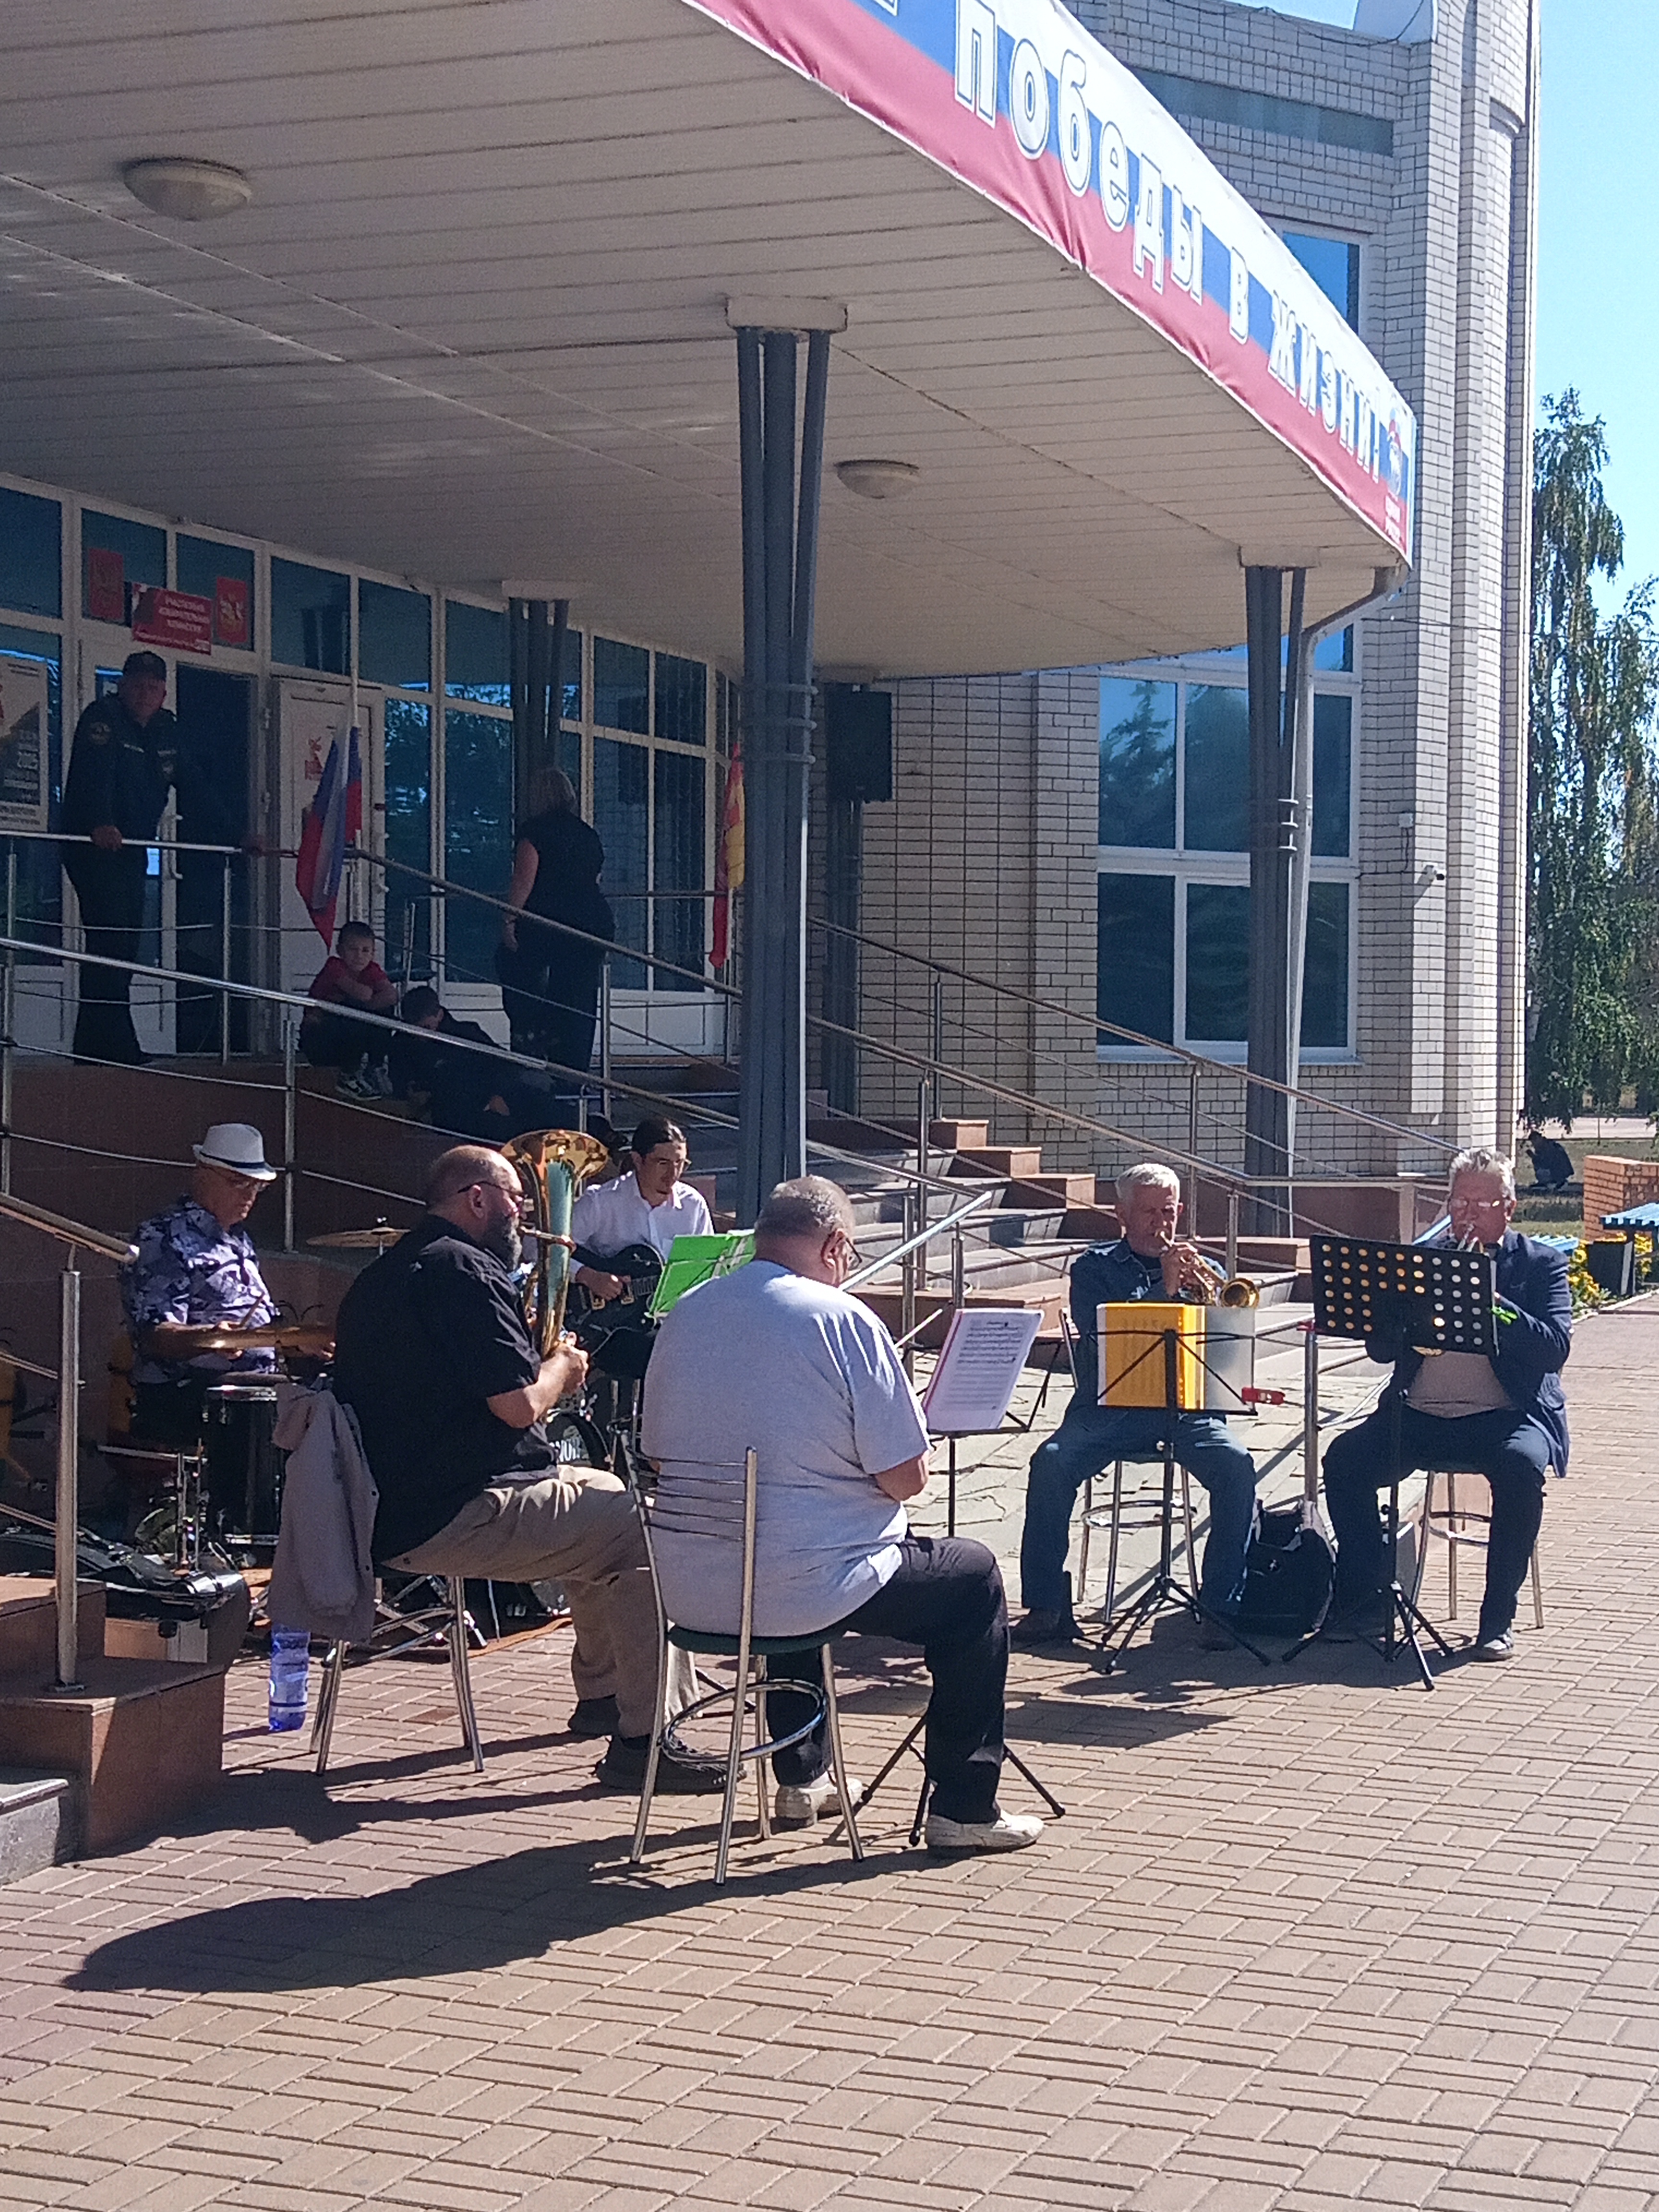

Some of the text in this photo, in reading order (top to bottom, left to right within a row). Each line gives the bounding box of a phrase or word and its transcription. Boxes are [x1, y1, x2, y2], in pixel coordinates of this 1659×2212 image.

[955, 0, 1381, 484] победы в жизни!
